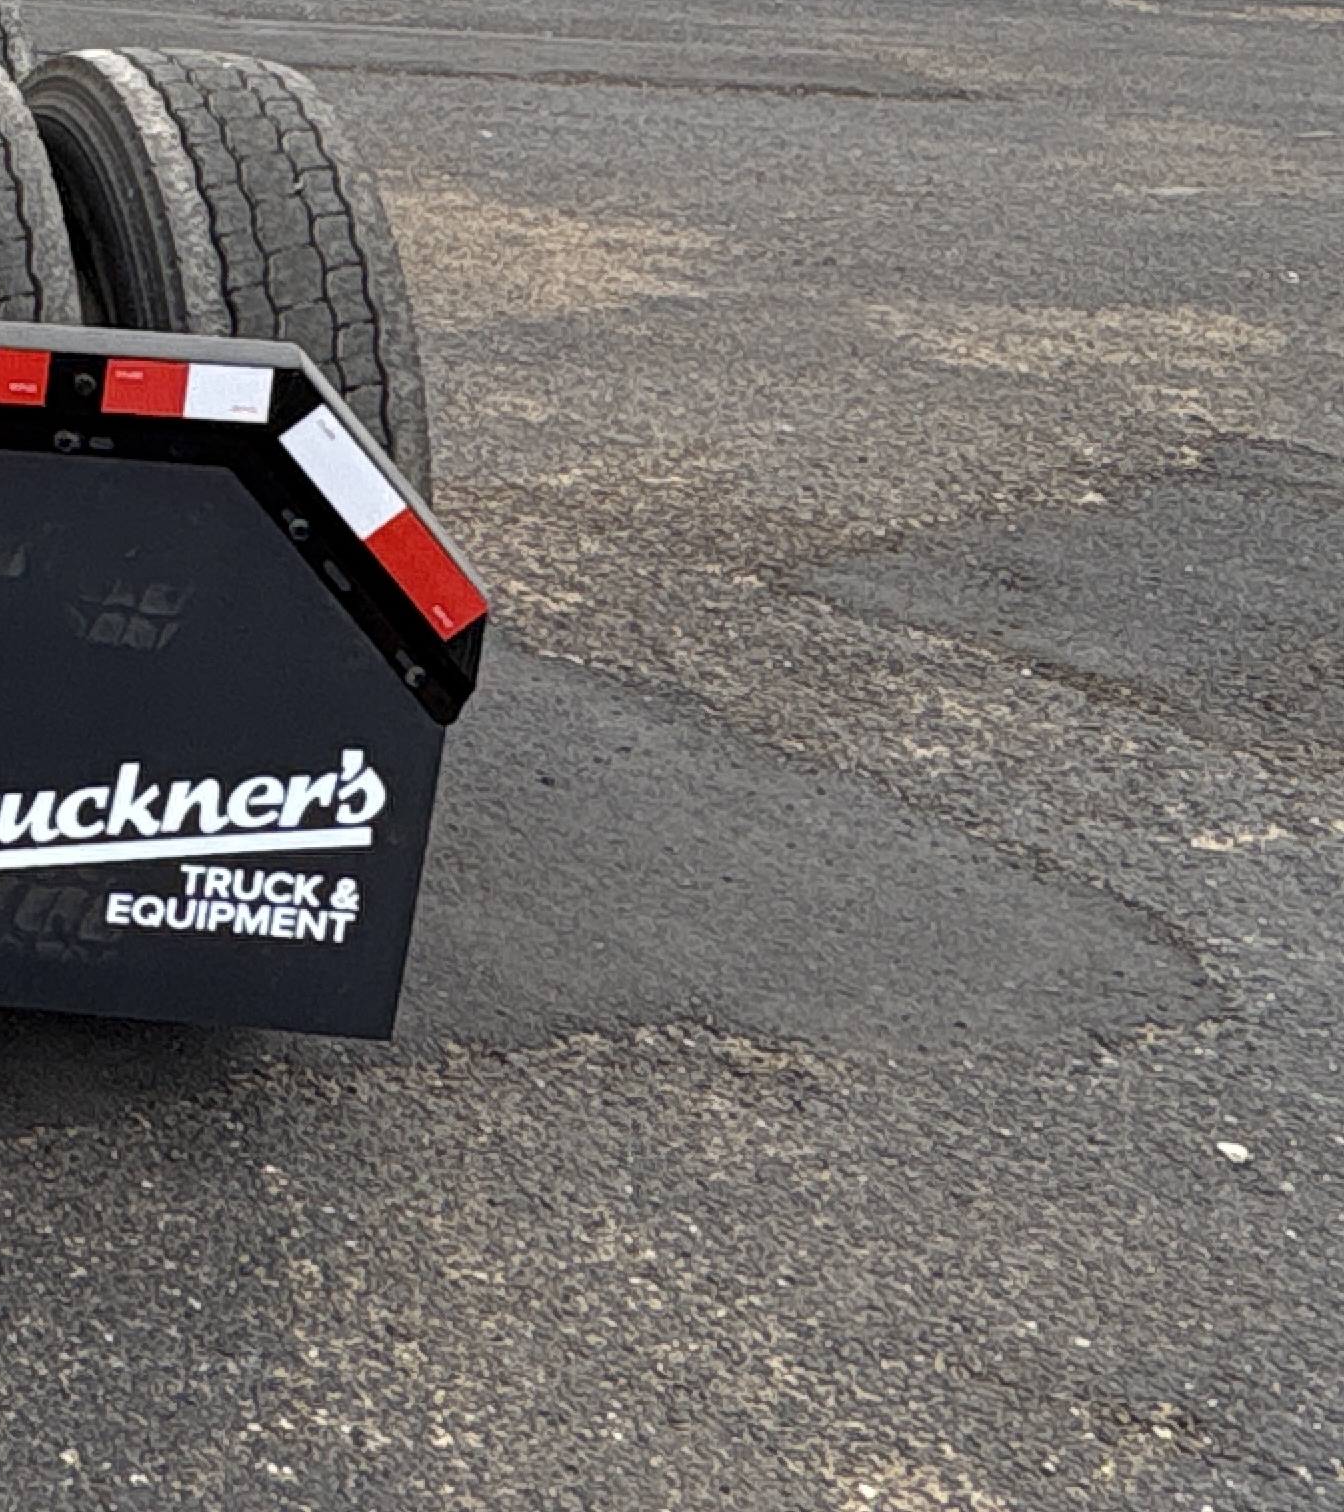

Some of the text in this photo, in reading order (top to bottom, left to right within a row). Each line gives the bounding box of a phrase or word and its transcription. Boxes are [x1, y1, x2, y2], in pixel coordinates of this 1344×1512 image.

[180, 864, 360, 912] TRUCK &
[106, 892, 356, 944] EQUIPMENT
